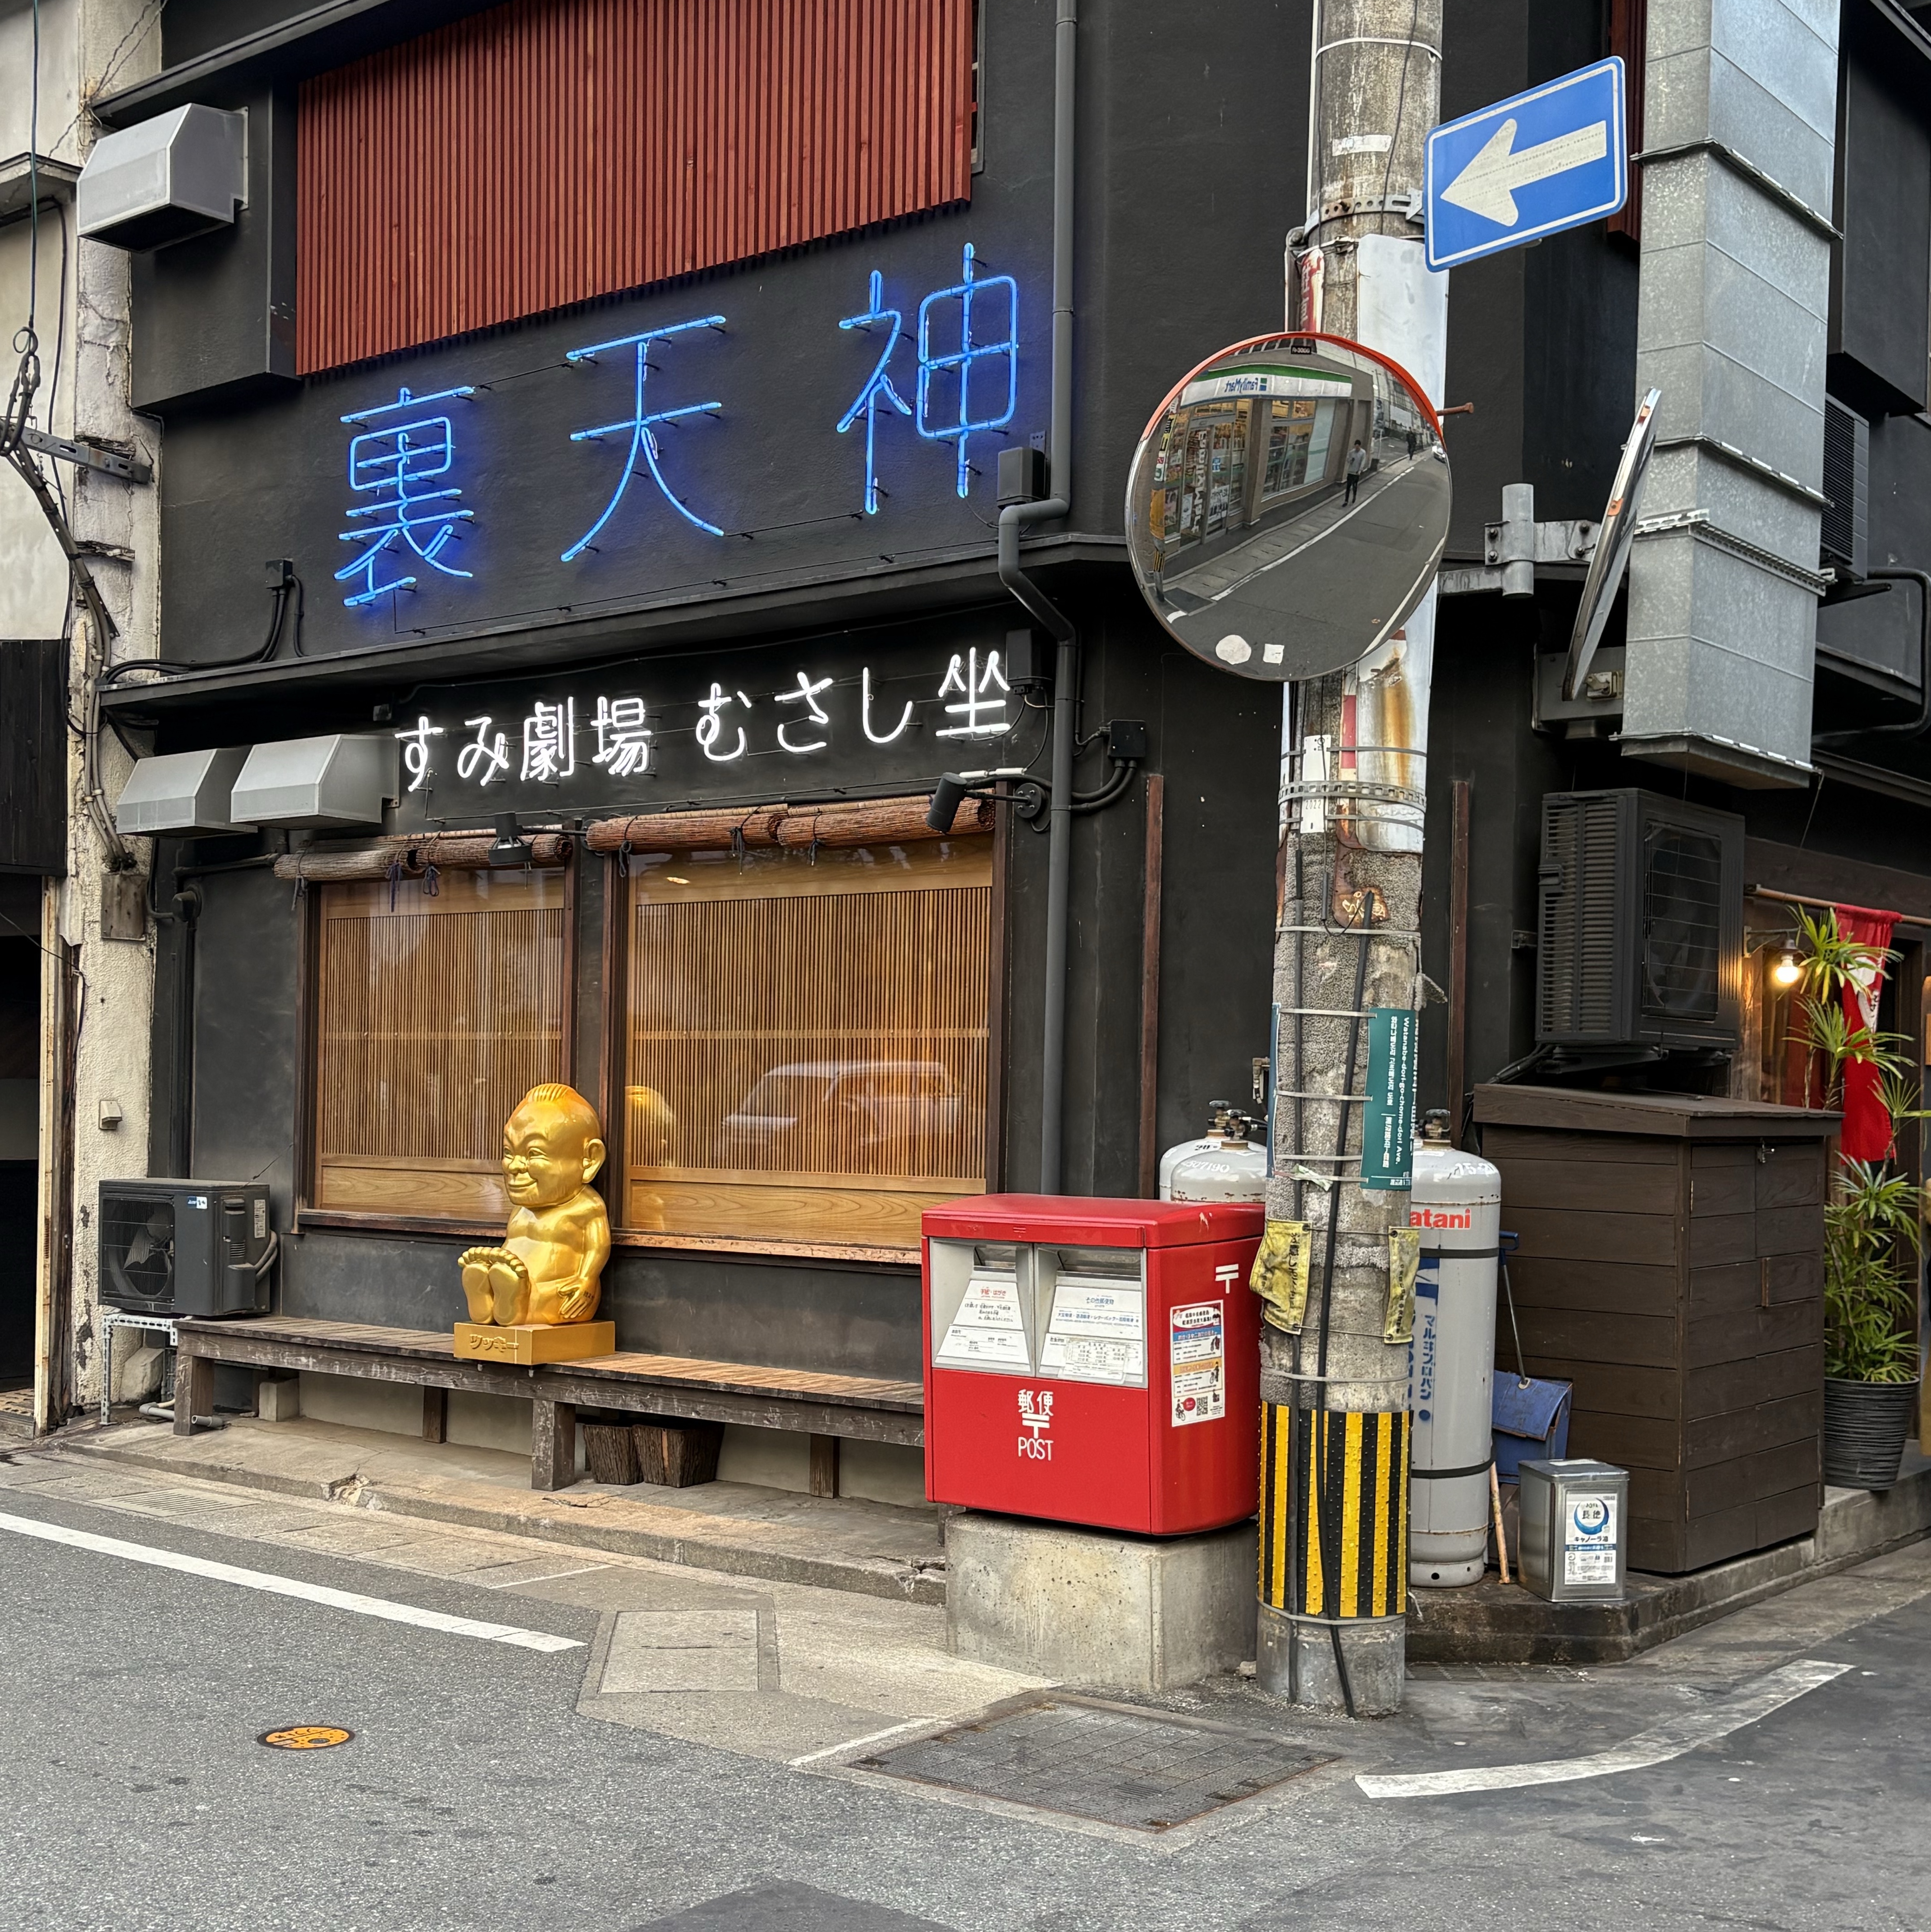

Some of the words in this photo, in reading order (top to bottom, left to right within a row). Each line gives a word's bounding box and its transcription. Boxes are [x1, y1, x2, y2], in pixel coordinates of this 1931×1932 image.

[334, 243, 1019, 607] 裏天神
[394, 696, 652, 792] すみ劇場
[1305, 799, 1321, 810] 2022
[1394, 1145, 1403, 1165] Ave.
[1017, 1389, 1054, 1417] 郵便
[1018, 1436, 1054, 1461] POST
